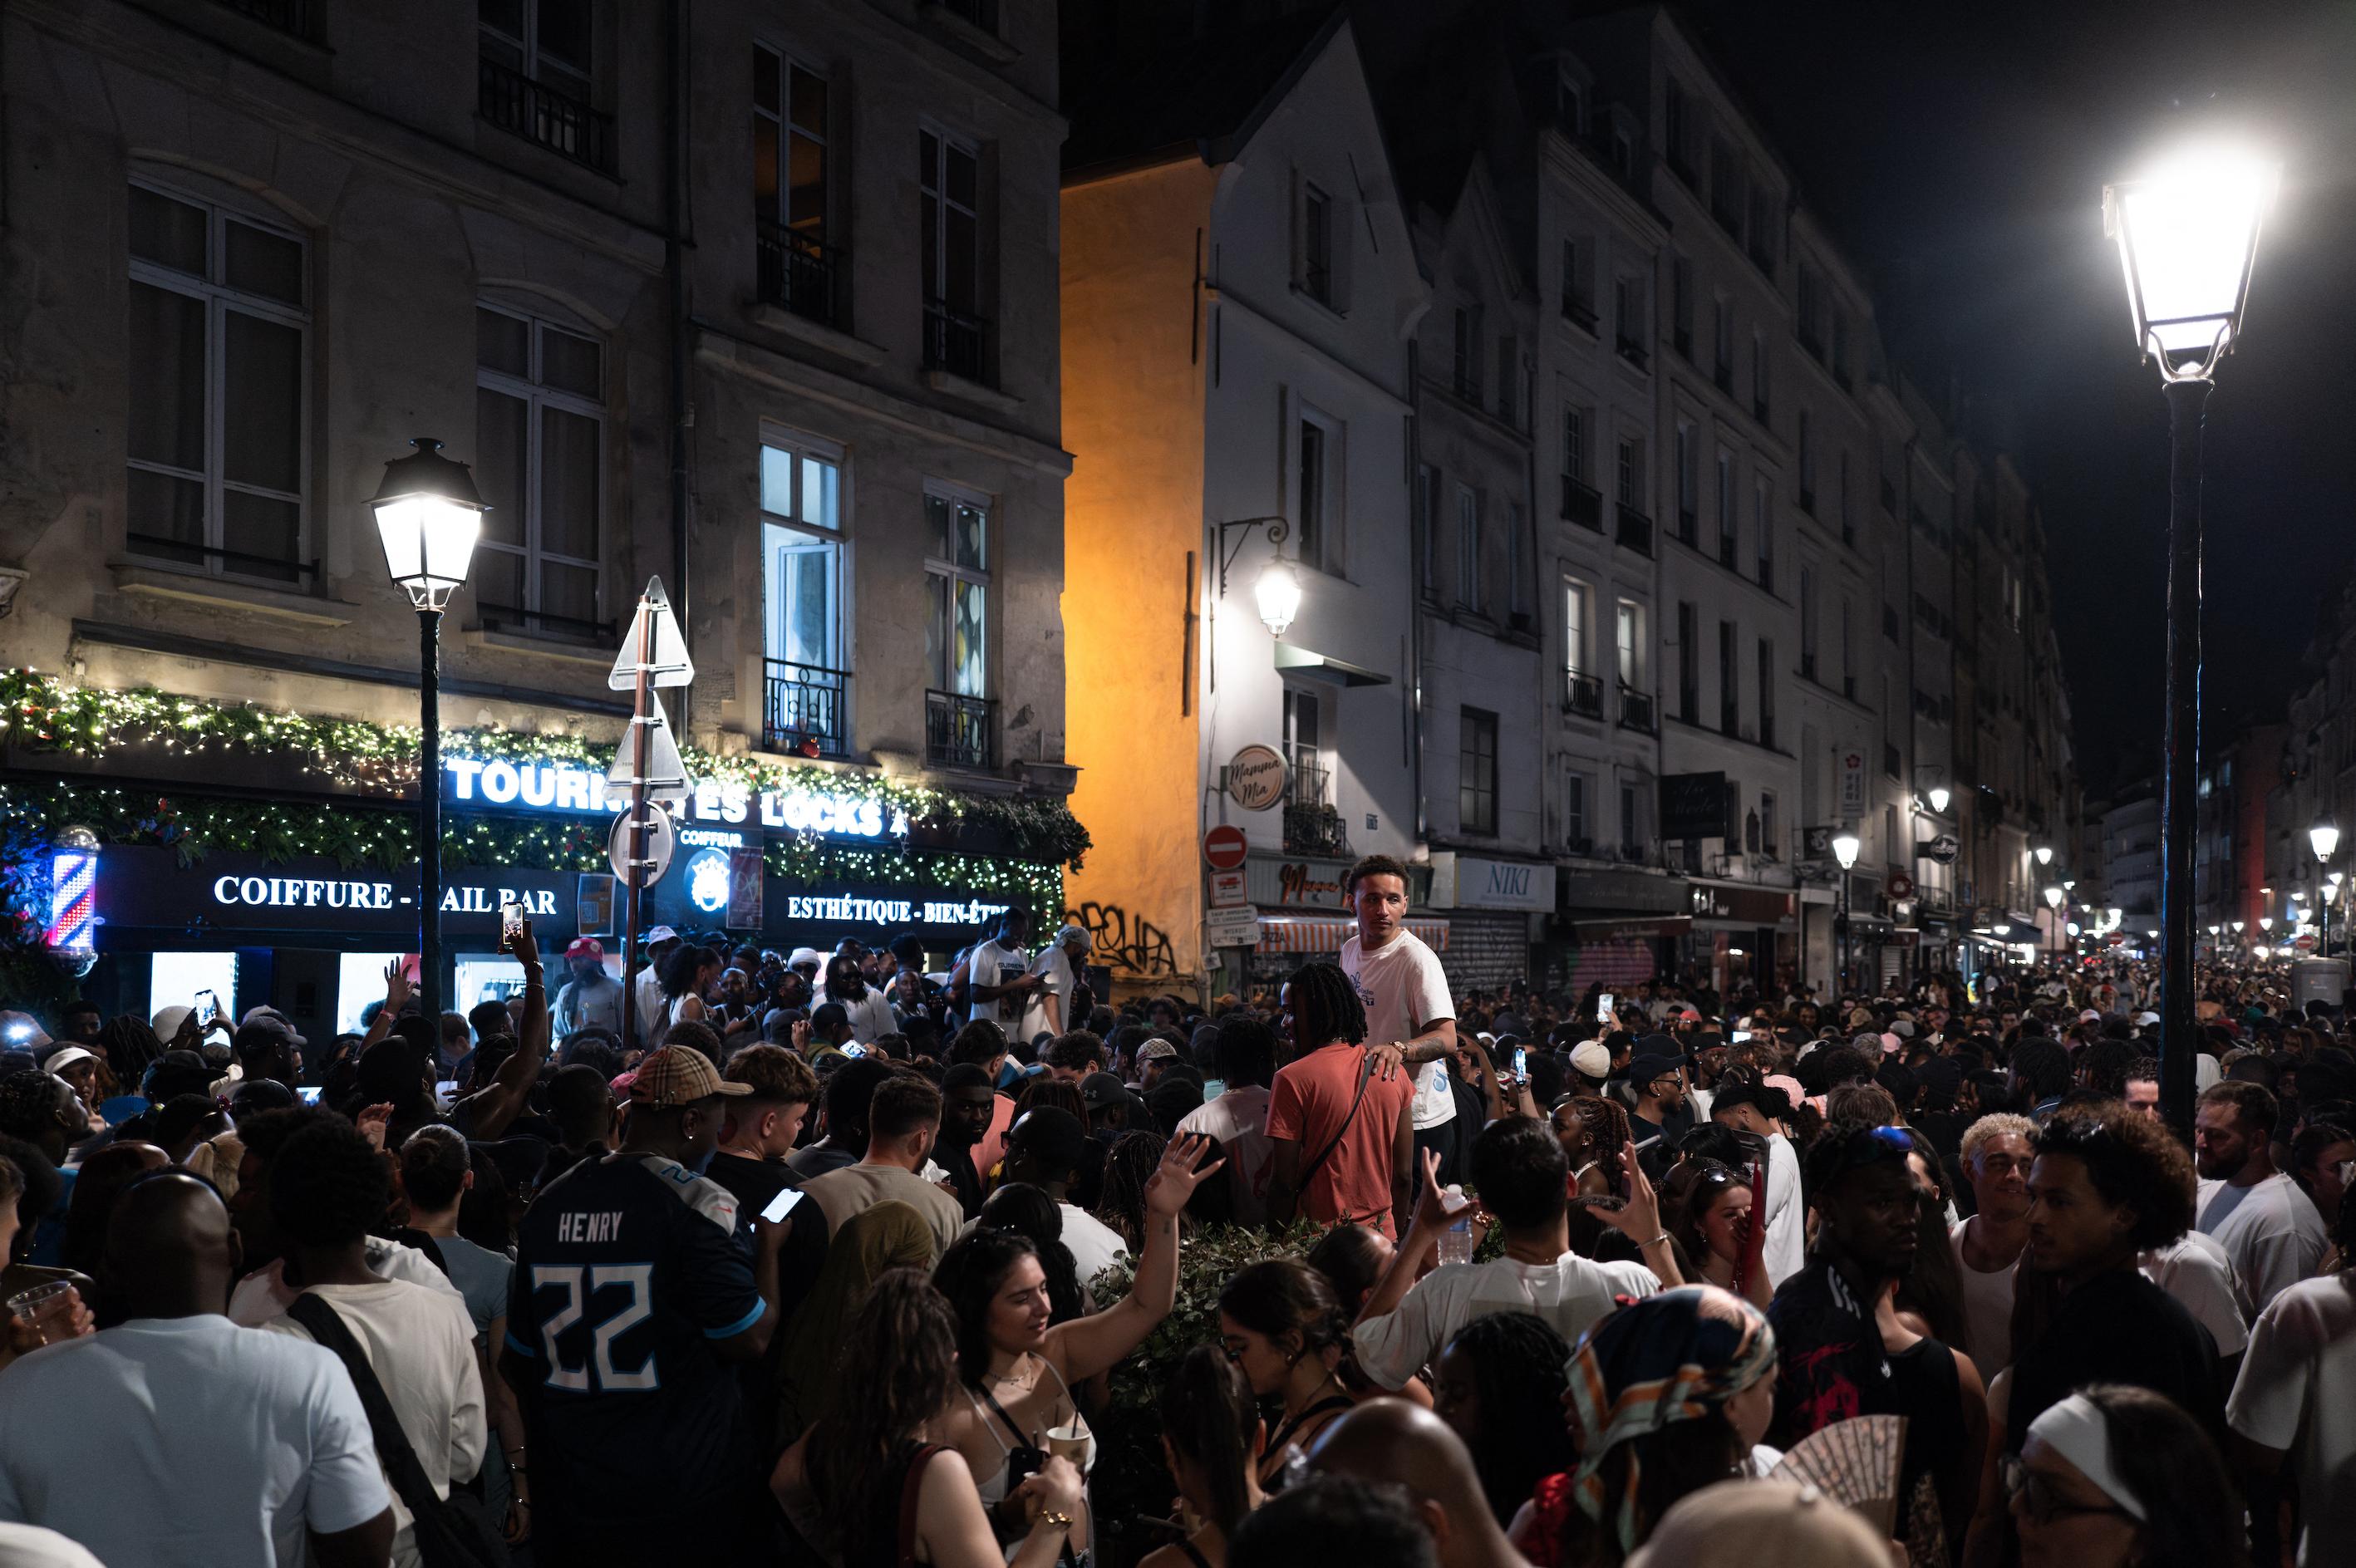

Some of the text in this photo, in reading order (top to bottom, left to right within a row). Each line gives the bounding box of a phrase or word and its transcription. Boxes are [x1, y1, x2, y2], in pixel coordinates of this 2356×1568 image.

[1230, 759, 1281, 785] Mamma
[446, 757, 636, 812] TOURN
[761, 790, 882, 836] LOCKS
[1242, 781, 1269, 804] Mia
[680, 829, 743, 848] COIFFEUR
[214, 875, 393, 909] COIFFURE
[417, 885, 492, 913] AIL
[1487, 865, 1531, 896] NIKI
[787, 892, 912, 926] ESTHÉTIQUE
[1261, 931, 1286, 943] PIZZA
[558, 1211, 623, 1243] HENRY
[530, 1261, 662, 1394] 22
